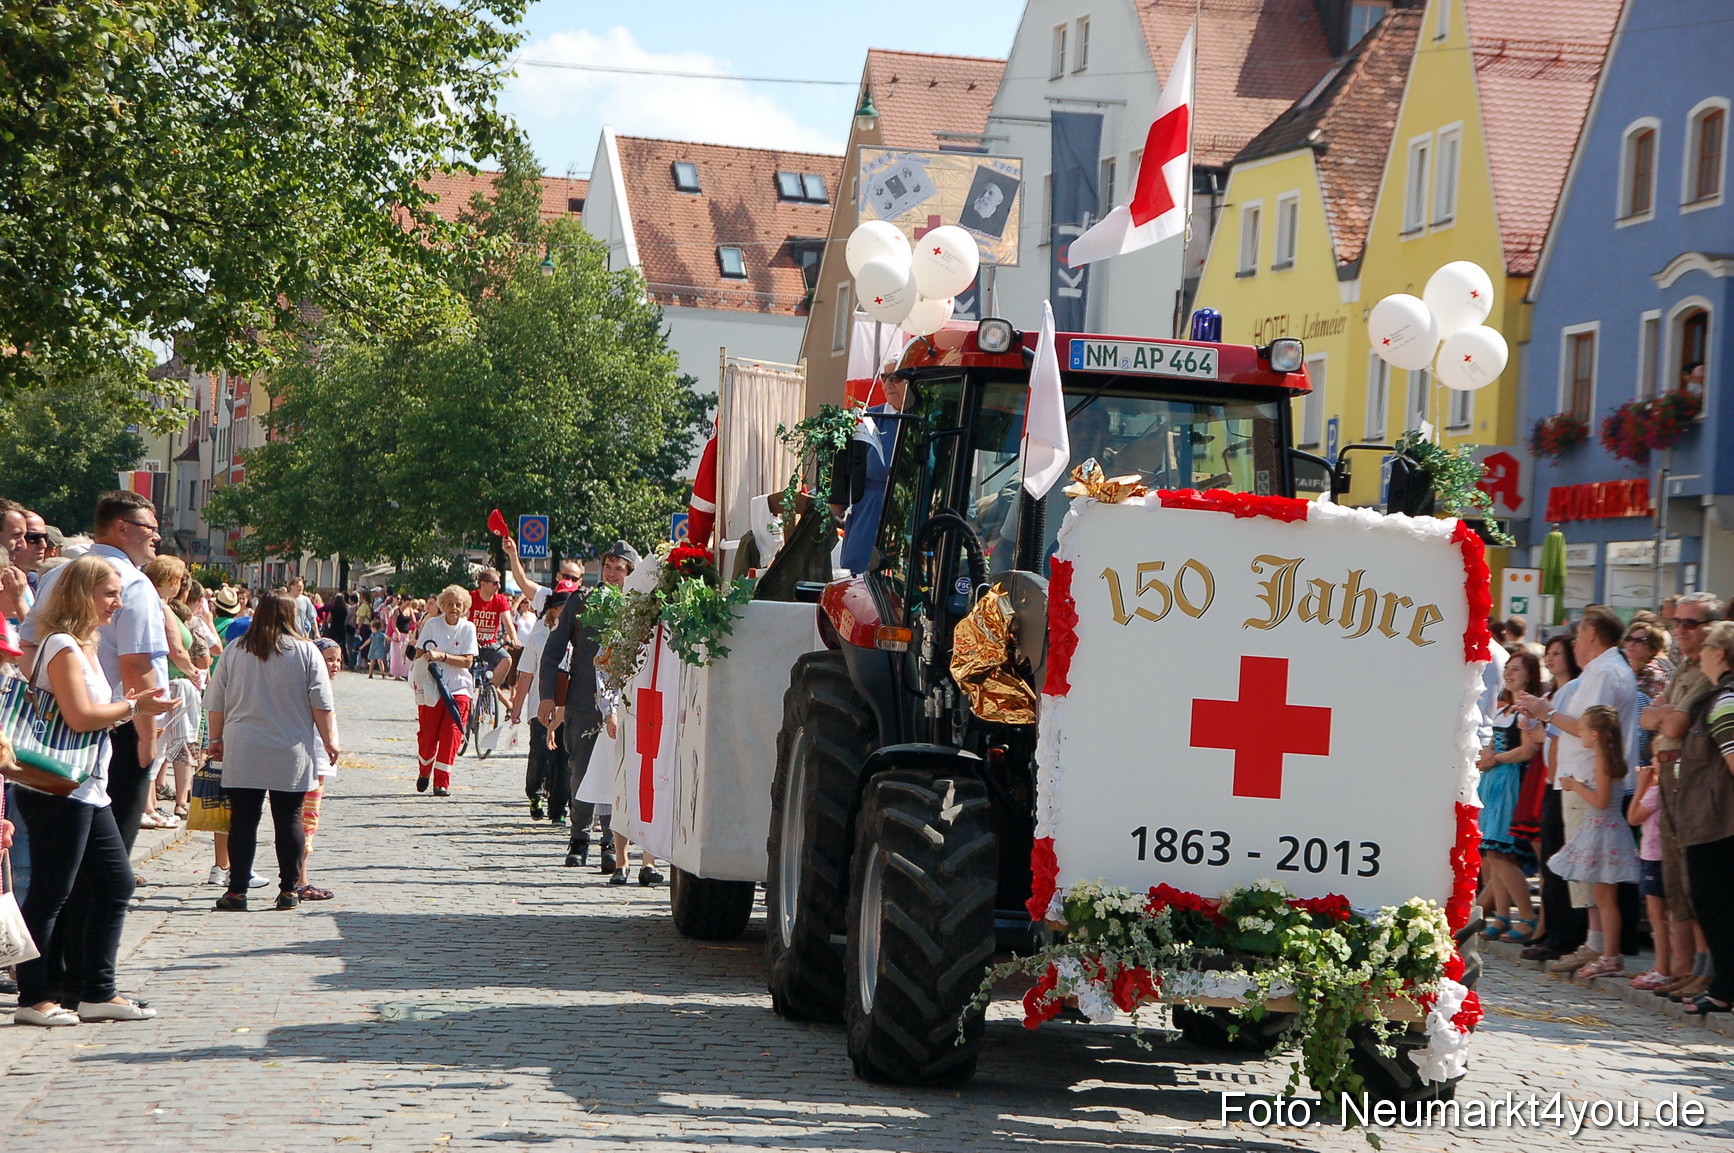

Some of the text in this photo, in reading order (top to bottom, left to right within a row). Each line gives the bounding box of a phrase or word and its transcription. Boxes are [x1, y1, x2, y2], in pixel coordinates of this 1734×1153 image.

[993, 160, 1019, 175] 1901
[1302, 309, 1347, 340] Lehmeier
[1086, 344, 1118, 367] NM
[1133, 346, 1164, 369] AP
[1169, 349, 1213, 375] 464
[521, 544, 545, 555] TAXI
[473, 610, 497, 620] FOOT
[1098, 553, 1445, 648] 150 Jahre
[1130, 825, 1382, 878] 1863 - 2013
